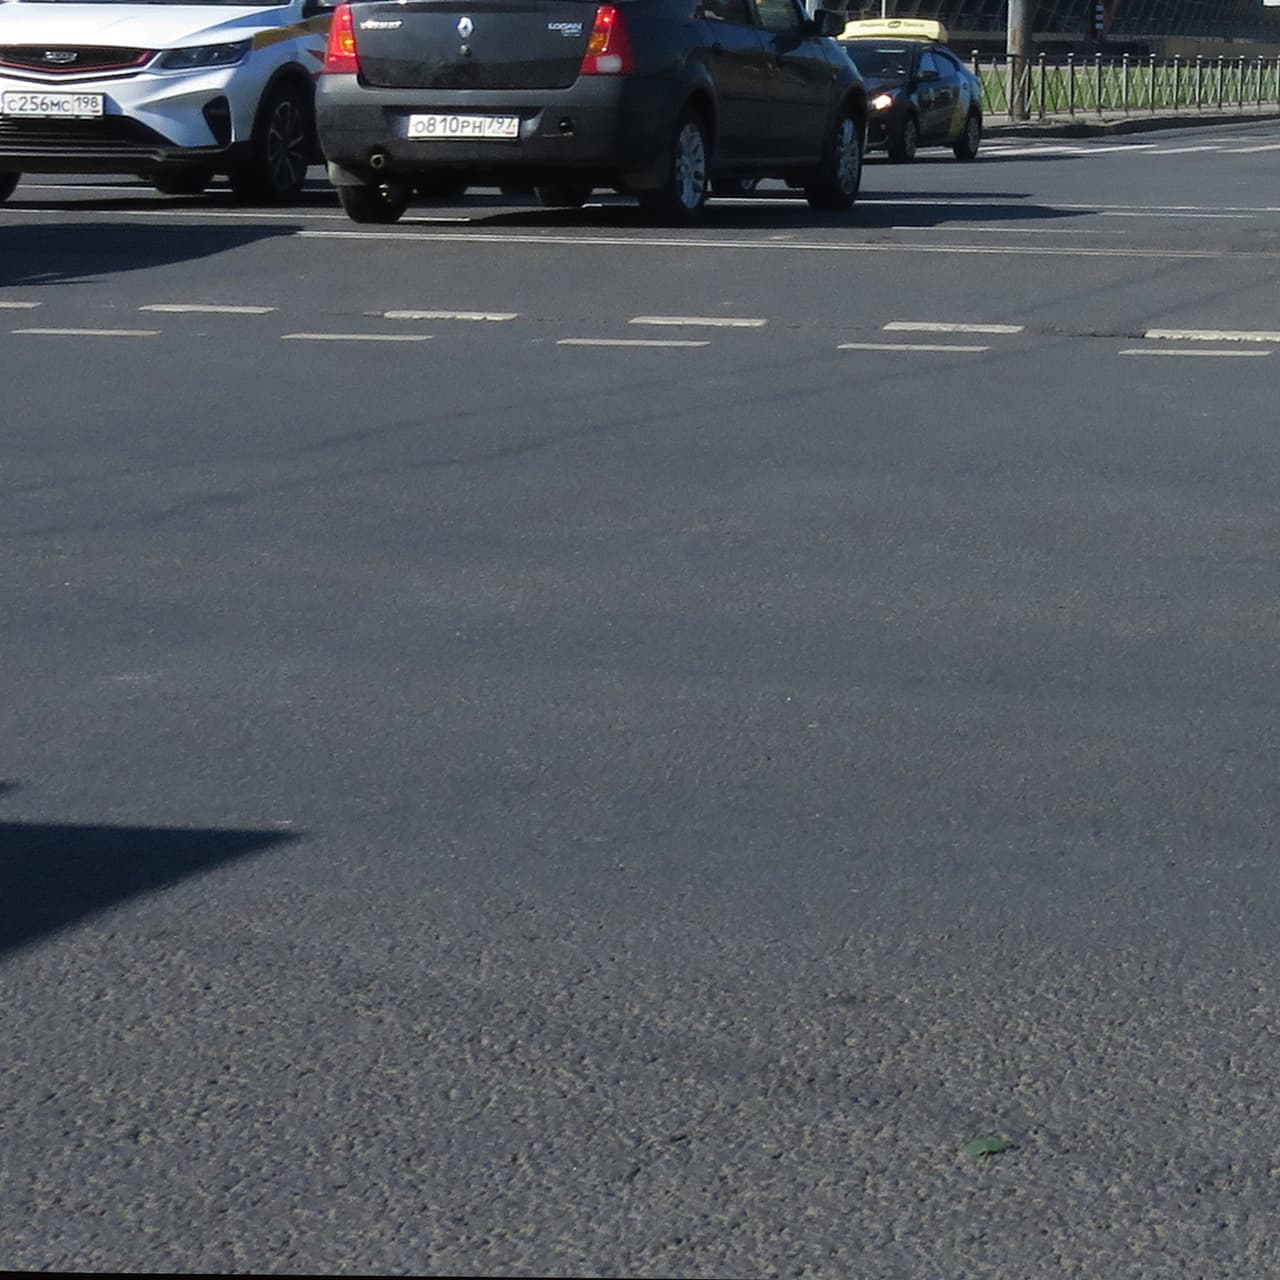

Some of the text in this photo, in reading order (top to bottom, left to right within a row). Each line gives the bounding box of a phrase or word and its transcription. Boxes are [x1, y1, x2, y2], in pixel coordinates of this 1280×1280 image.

[7, 96, 99, 112] С256МС 198
[414, 117, 482, 132] О810РН
